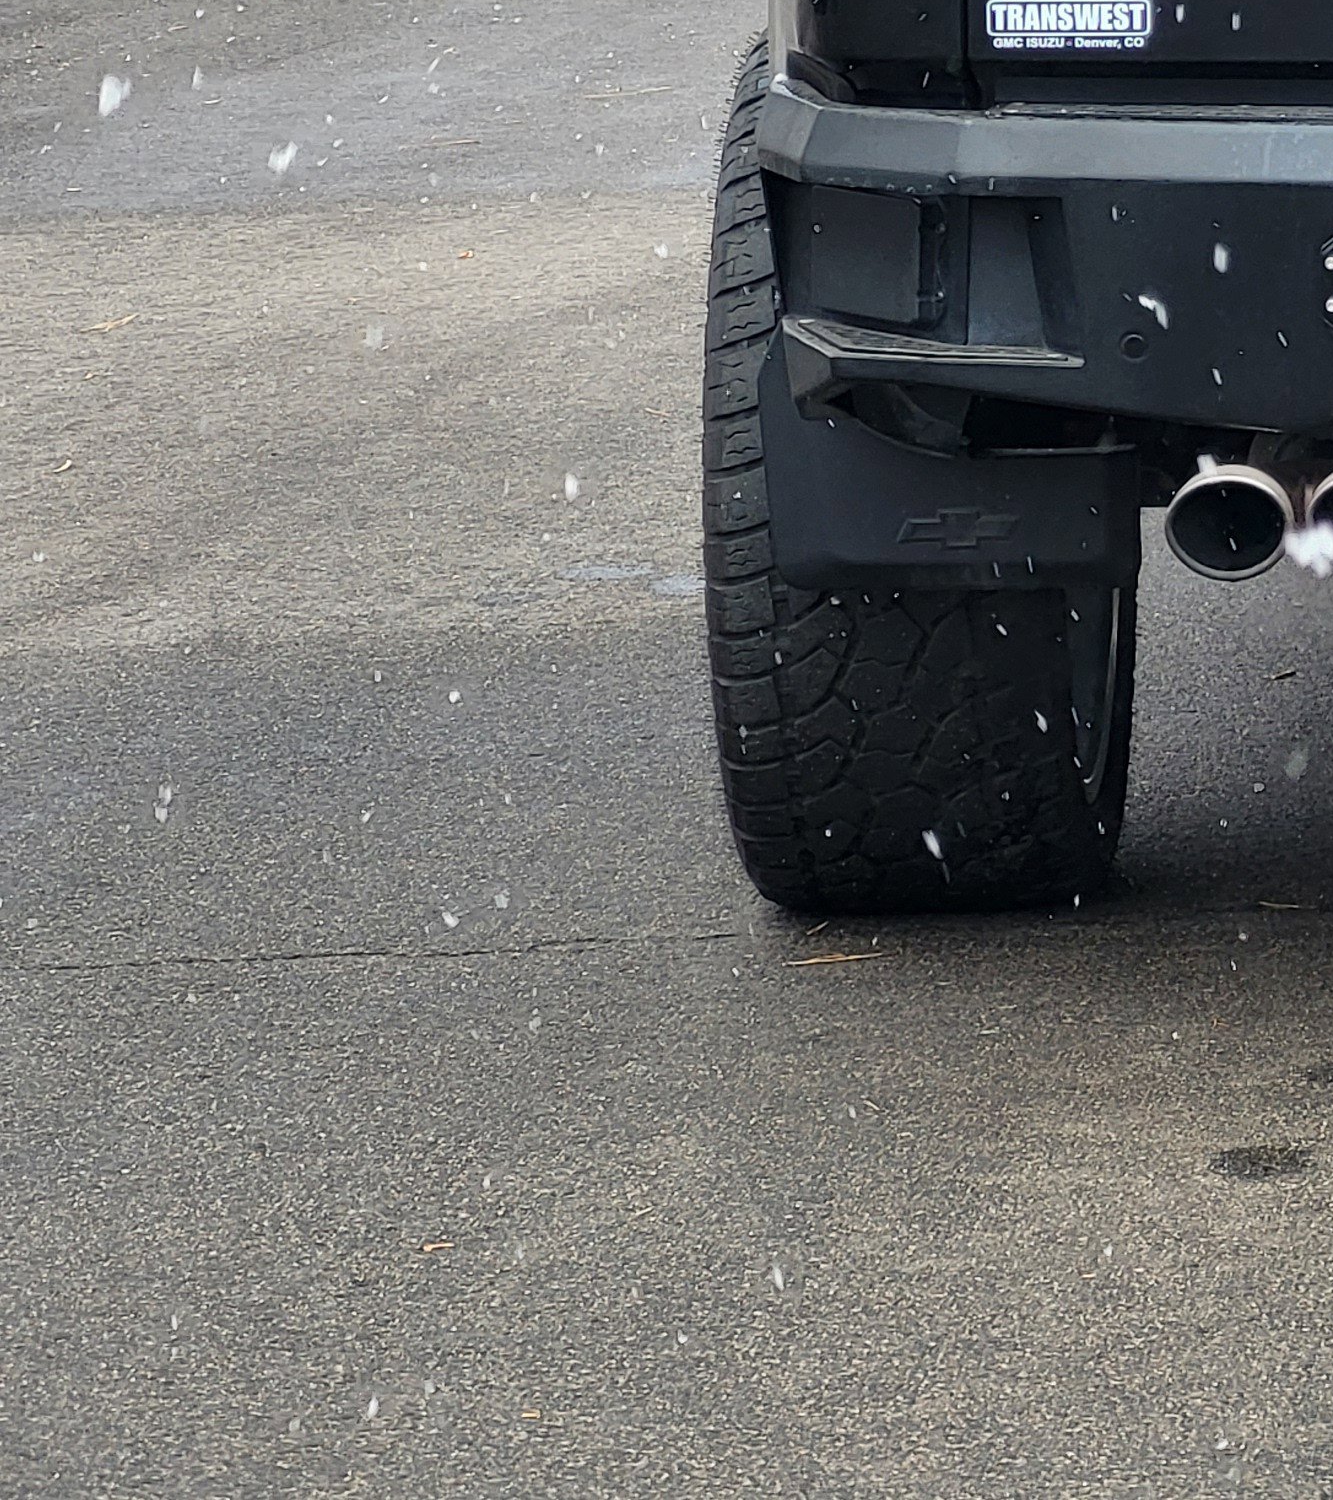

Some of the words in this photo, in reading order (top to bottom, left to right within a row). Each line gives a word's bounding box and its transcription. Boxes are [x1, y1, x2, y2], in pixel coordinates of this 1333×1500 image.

[991, 3, 1145, 31] TRANSWEST
[993, 37, 1023, 48] GMC
[1026, 37, 1064, 48] ISUZU
[1074, 37, 1121, 49] Denver,
[1124, 37, 1144, 48] CO
